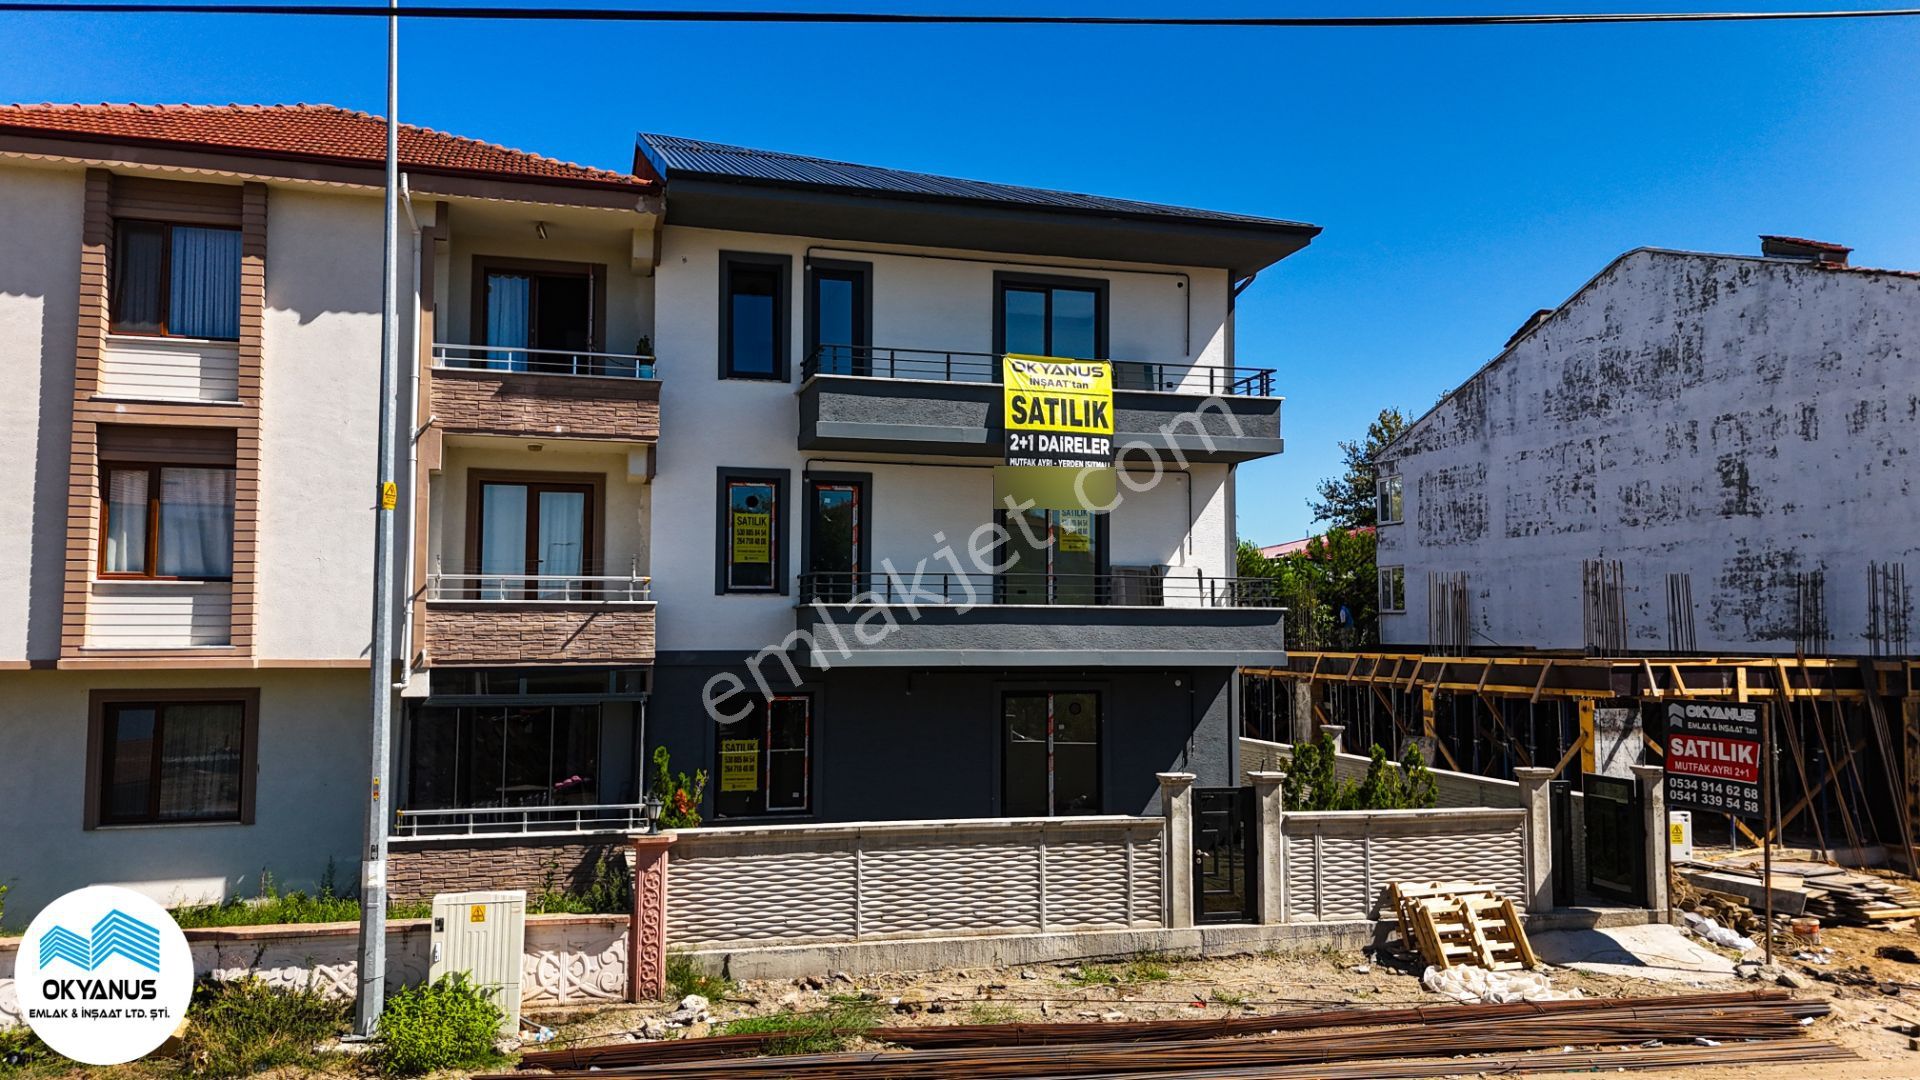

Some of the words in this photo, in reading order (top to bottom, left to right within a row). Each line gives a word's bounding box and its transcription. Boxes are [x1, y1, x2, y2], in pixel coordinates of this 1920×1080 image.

[1011, 361, 1105, 378] OKYANUS
[1011, 395, 1109, 429] SATILIK
[1010, 433, 1034, 451] 2+1
[1009, 458, 1036, 467] MUTFAK
[1038, 458, 1053, 467] AYRI
[1058, 459, 1084, 468] YERDEN
[737, 516, 767, 526] SATILIK
[1685, 704, 1756, 722] OKYANUS
[1687, 721, 1711, 731] EMLAK
[1712, 723, 1717, 731] &
[725, 743, 755, 752] SATILIK
[1670, 738, 1754, 764] SATILIK
[1675, 761, 1711, 774] MUTFAK
[1712, 765, 1732, 776] AYRI
[1734, 767, 1750, 778] 2+1
[1669, 777, 1698, 790] 0534
[1701, 781, 1723, 794] 914
[1726, 785, 1741, 797] 62
[1744, 788, 1758, 800] 68
[1669, 790, 1697, 803] 0541
[1701, 793, 1723, 806] 339
[1726, 797, 1741, 809] 54
[1744, 801, 1759, 813] 58
